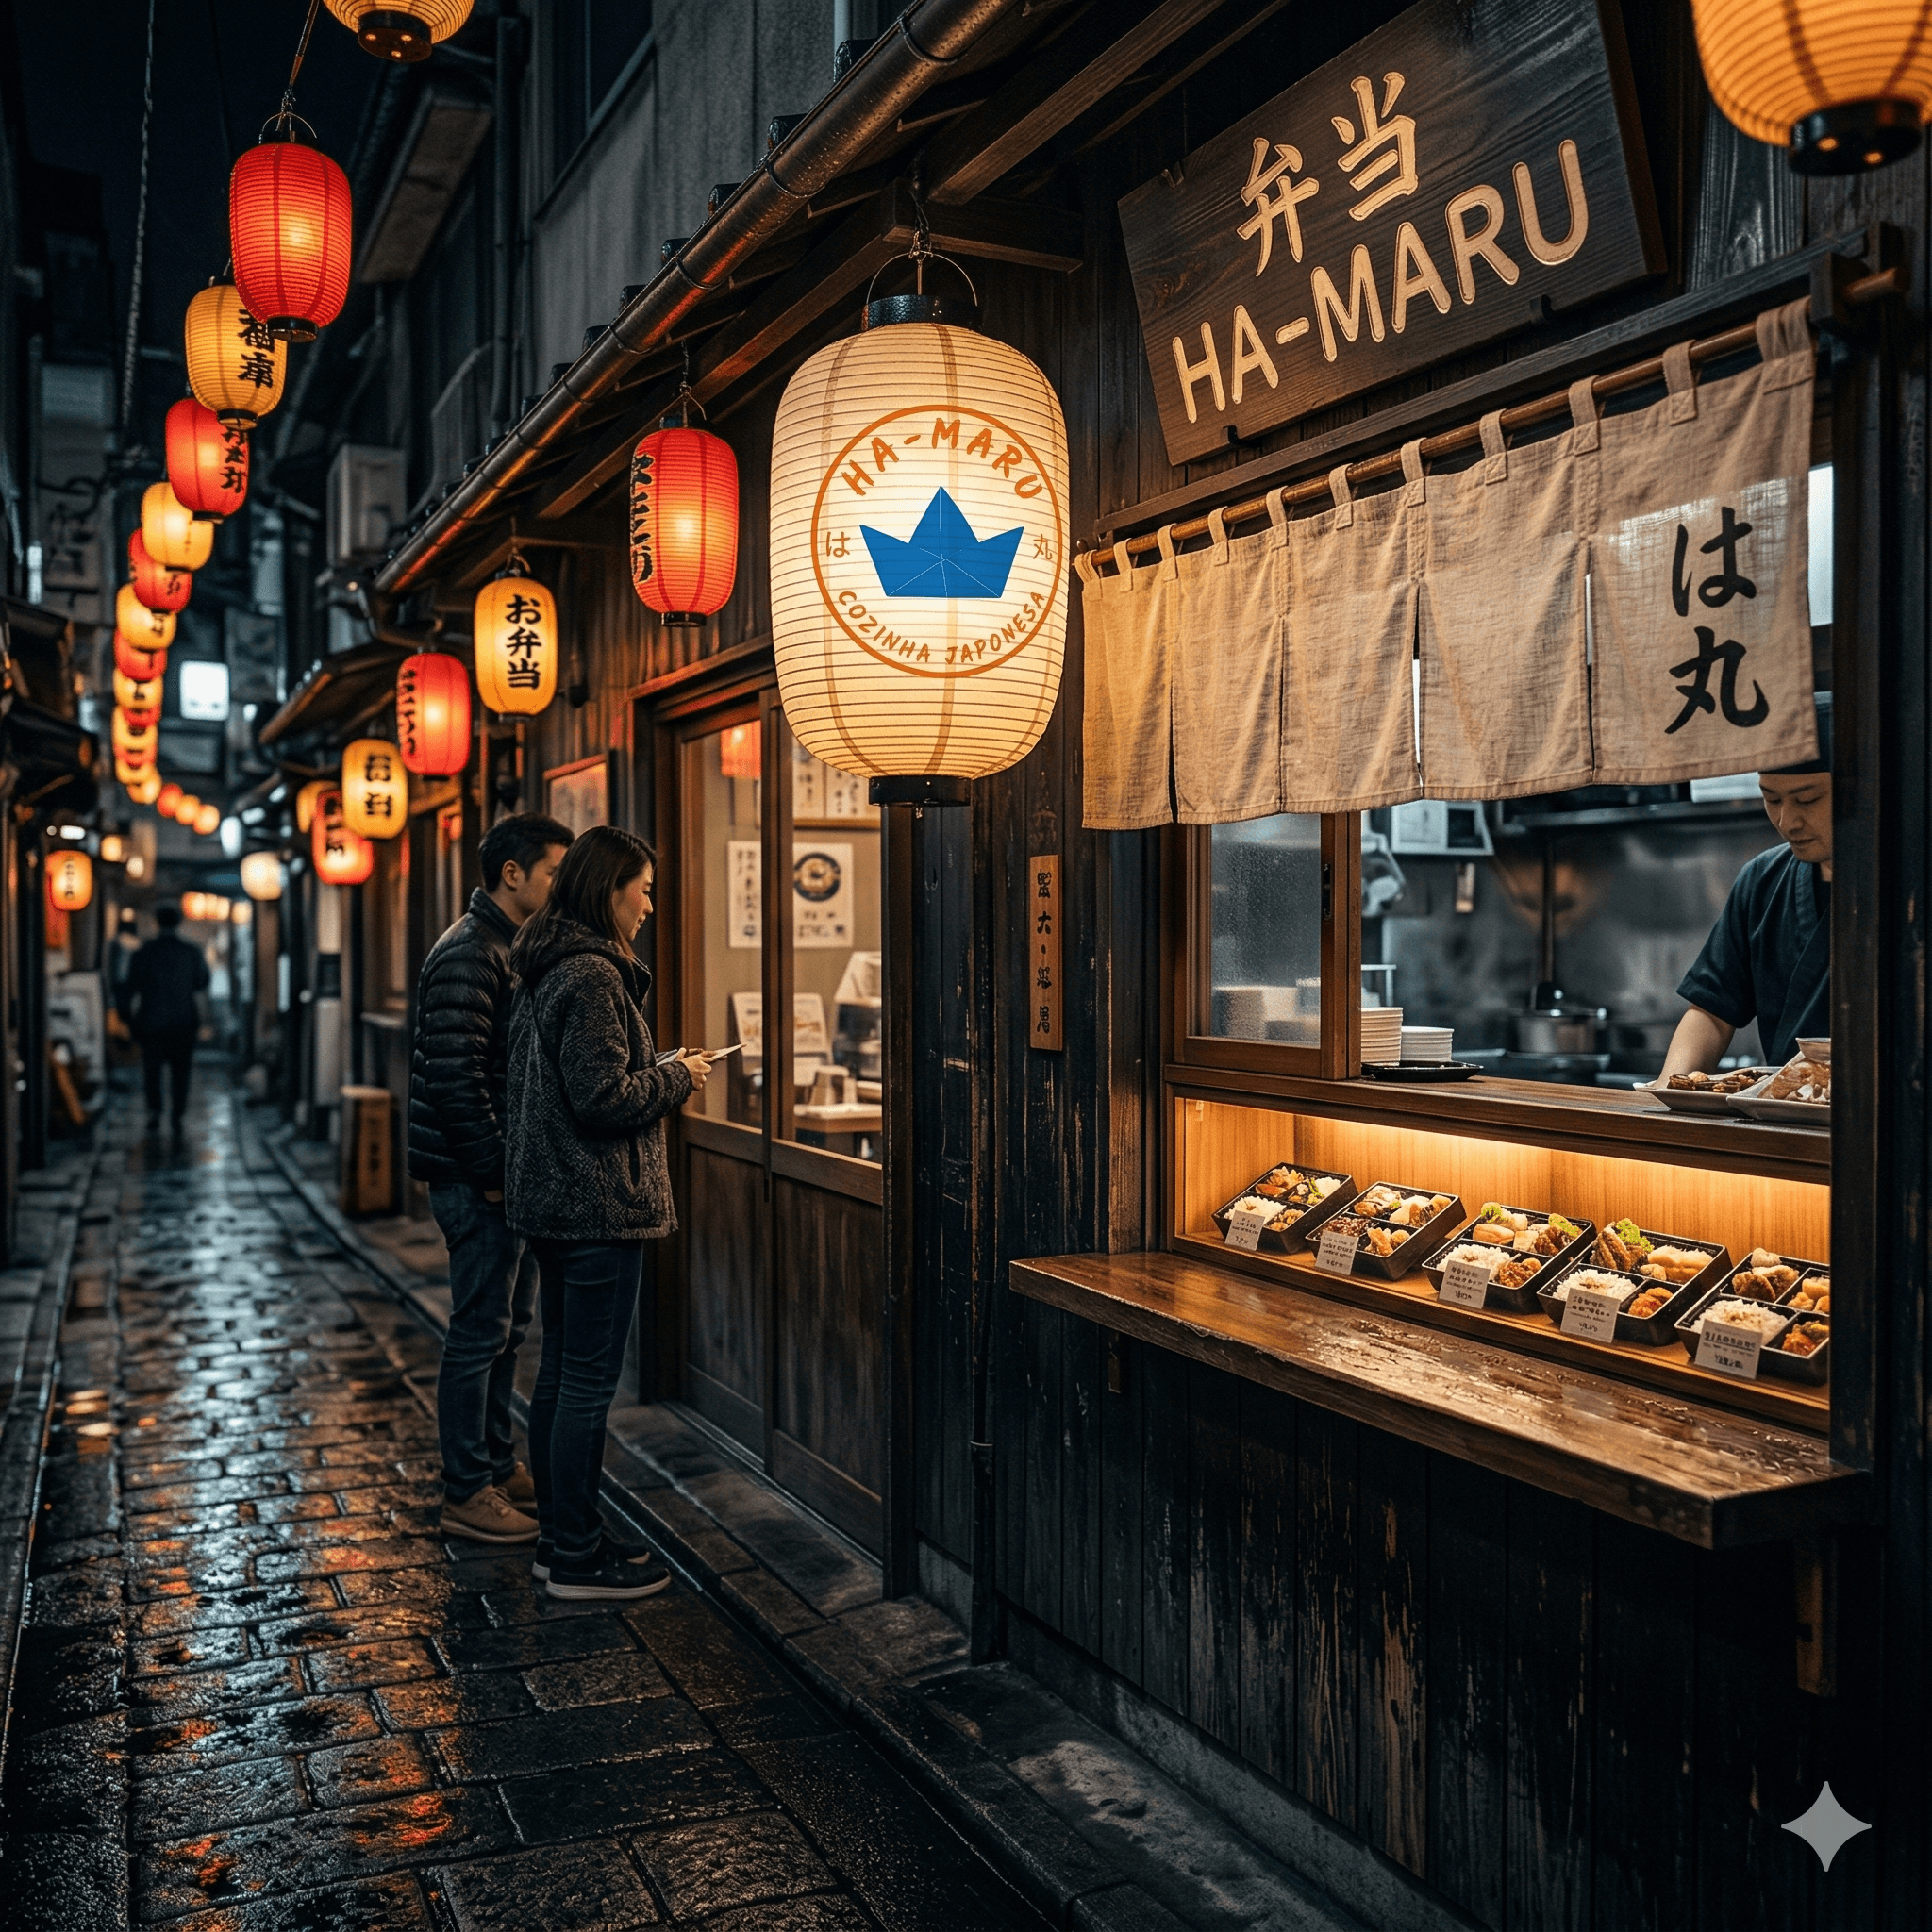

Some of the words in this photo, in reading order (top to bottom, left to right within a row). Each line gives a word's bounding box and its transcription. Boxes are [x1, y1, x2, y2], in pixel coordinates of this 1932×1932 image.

[1237, 72, 1419, 277] 弁当
[1172, 139, 1590, 424] HA-MARU
[841, 418, 1043, 499] HA-MARU
[825, 531, 850, 558] は
[1033, 533, 1053, 560] 丸
[505, 593, 542, 691] お弁当
[838, 590, 932, 664] COZINHA
[944, 591, 1046, 665] JAPONESA
[1664, 506, 1770, 735] は丸
